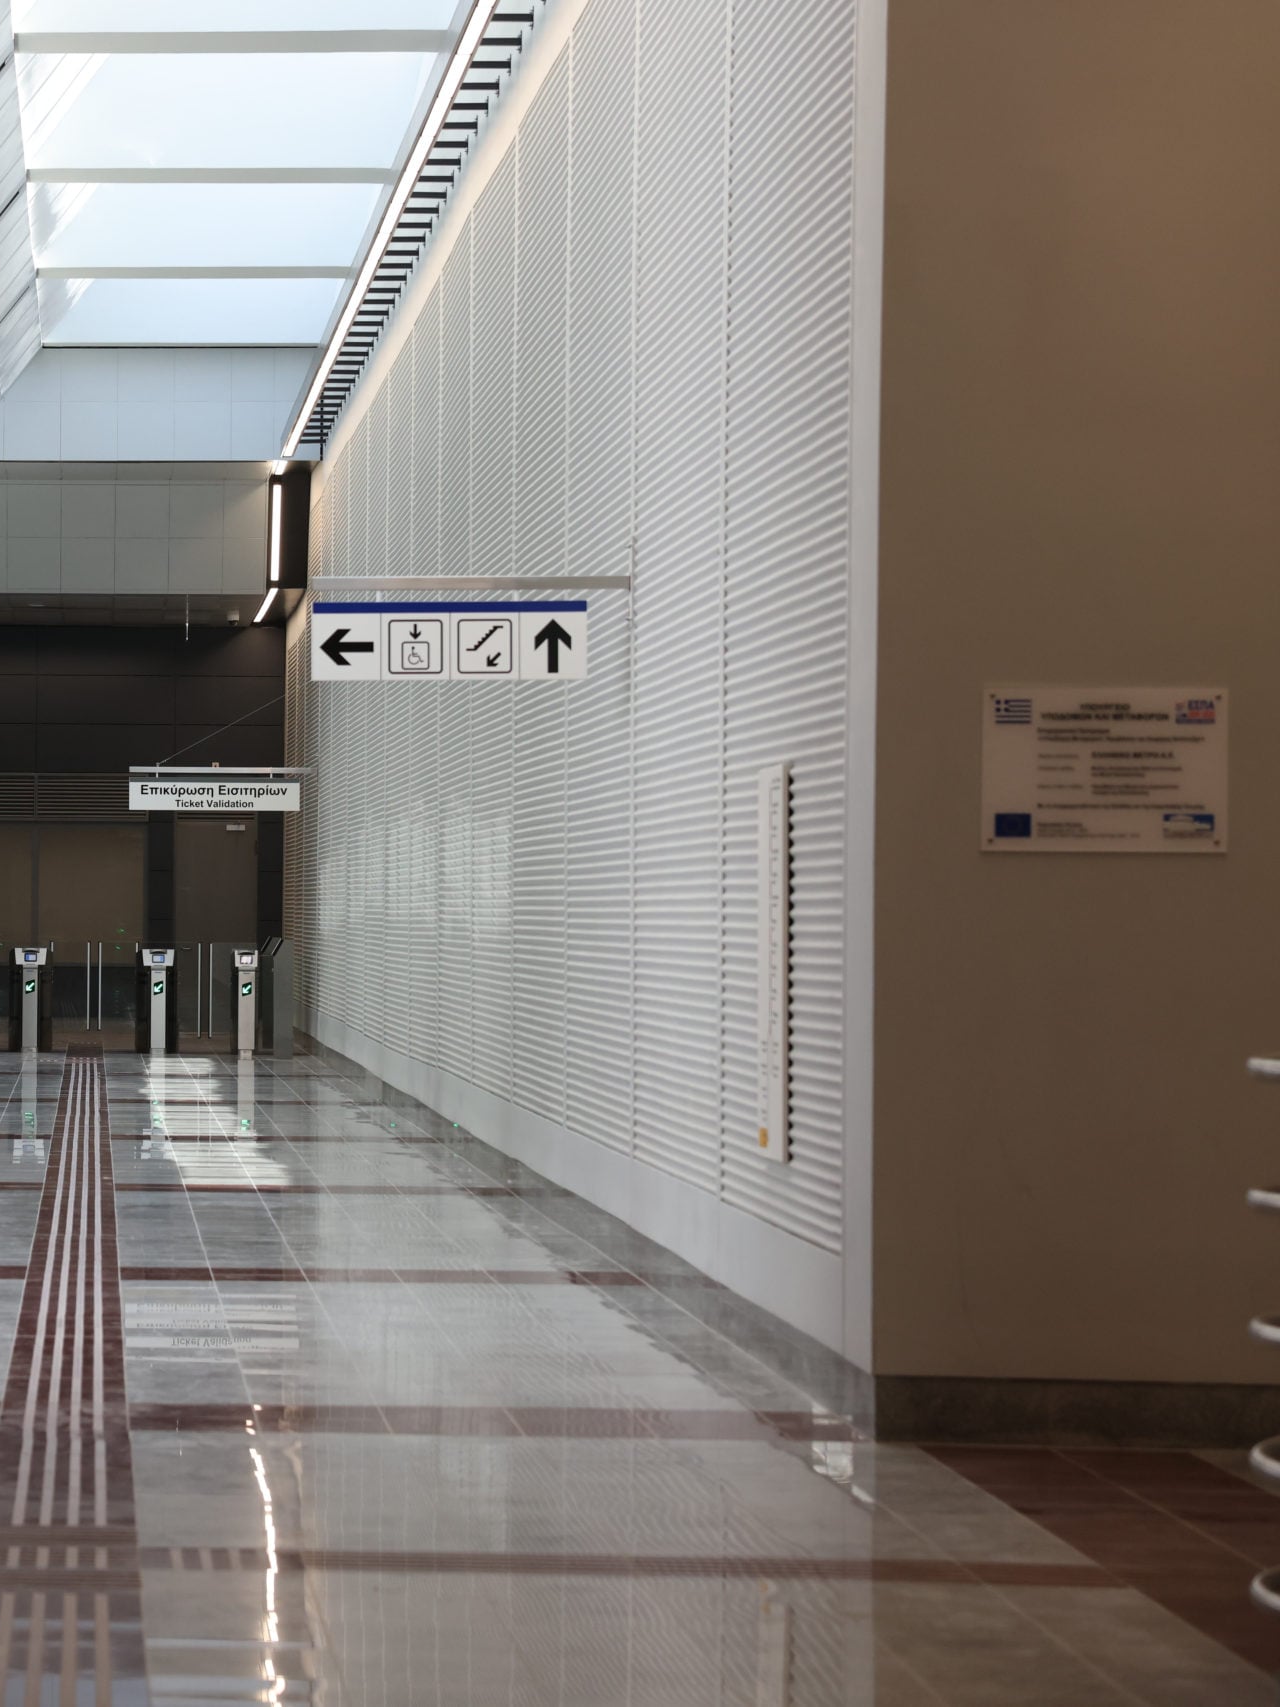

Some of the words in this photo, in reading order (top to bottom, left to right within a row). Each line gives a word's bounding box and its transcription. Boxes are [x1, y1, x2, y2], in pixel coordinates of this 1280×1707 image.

[140, 784, 214, 798] Επικύρωση
[218, 784, 288, 798] Εισιτηρίων
[175, 799, 204, 809] Ticket
[206, 799, 254, 809] Validation
